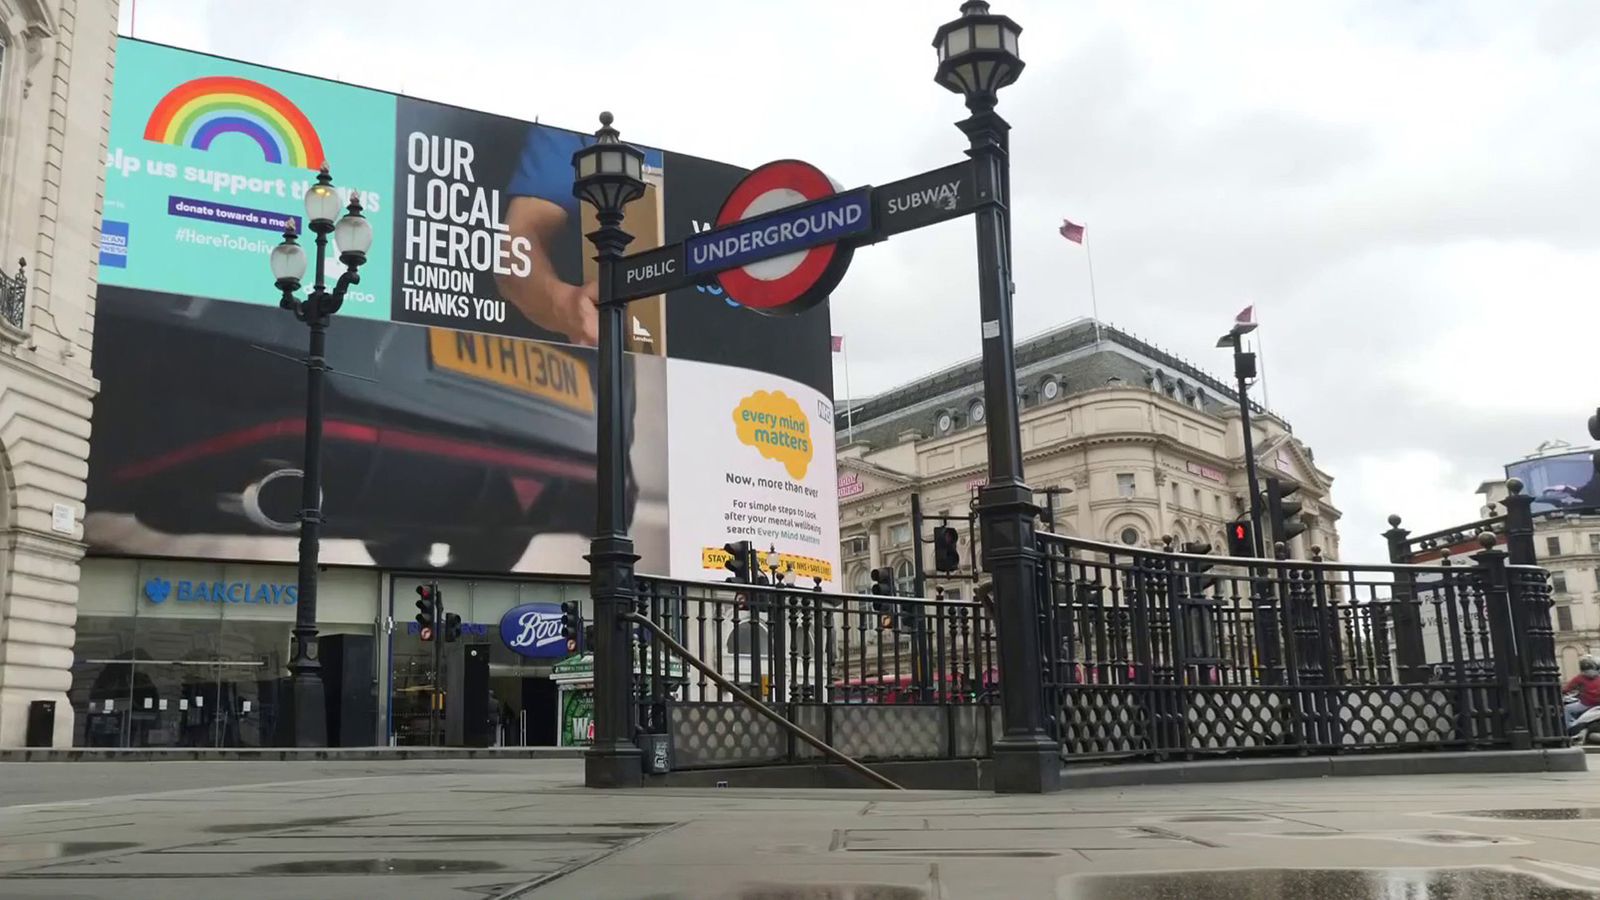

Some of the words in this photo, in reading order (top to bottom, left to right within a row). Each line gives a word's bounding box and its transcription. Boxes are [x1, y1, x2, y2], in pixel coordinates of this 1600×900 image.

[408, 131, 475, 183] OUR
[146, 160, 178, 178] us
[184, 166, 286, 198] support
[406, 174, 510, 233] LOCAL
[887, 180, 961, 215] SUBWAY
[175, 201, 214, 216] donate
[215, 208, 259, 223] towards
[693, 203, 863, 264] UNDERGROUND
[405, 218, 532, 278] HEROES
[403, 262, 474, 294] LONDON
[626, 258, 676, 284] PUBLIC
[402, 287, 469, 318] THANKS
[473, 298, 506, 323] YOU
[741, 409, 777, 429] every
[779, 414, 806, 433] mind
[754, 429, 809, 452] matters
[725, 472, 756, 488] Now,
[757, 477, 784, 490] more
[784, 480, 804, 495] than
[804, 486, 819, 499] ever
[732, 498, 748, 509] For
[748, 500, 777, 513] simple
[777, 505, 797, 517] steps
[797, 508, 805, 518] to
[804, 509, 817, 520] look
[724, 511, 746, 521] after
[747, 516, 767, 524] your
[767, 516, 794, 529] mental
[794, 521, 822, 536] wellbeing
[726, 525, 756, 535] search
[757, 526, 780, 540] Every
[780, 530, 799, 541] Mind
[799, 533, 821, 545] Matters
[707, 553, 728, 564] STAY
[176, 579, 299, 606] BARCLAYS
[509, 611, 568, 648] Boo
